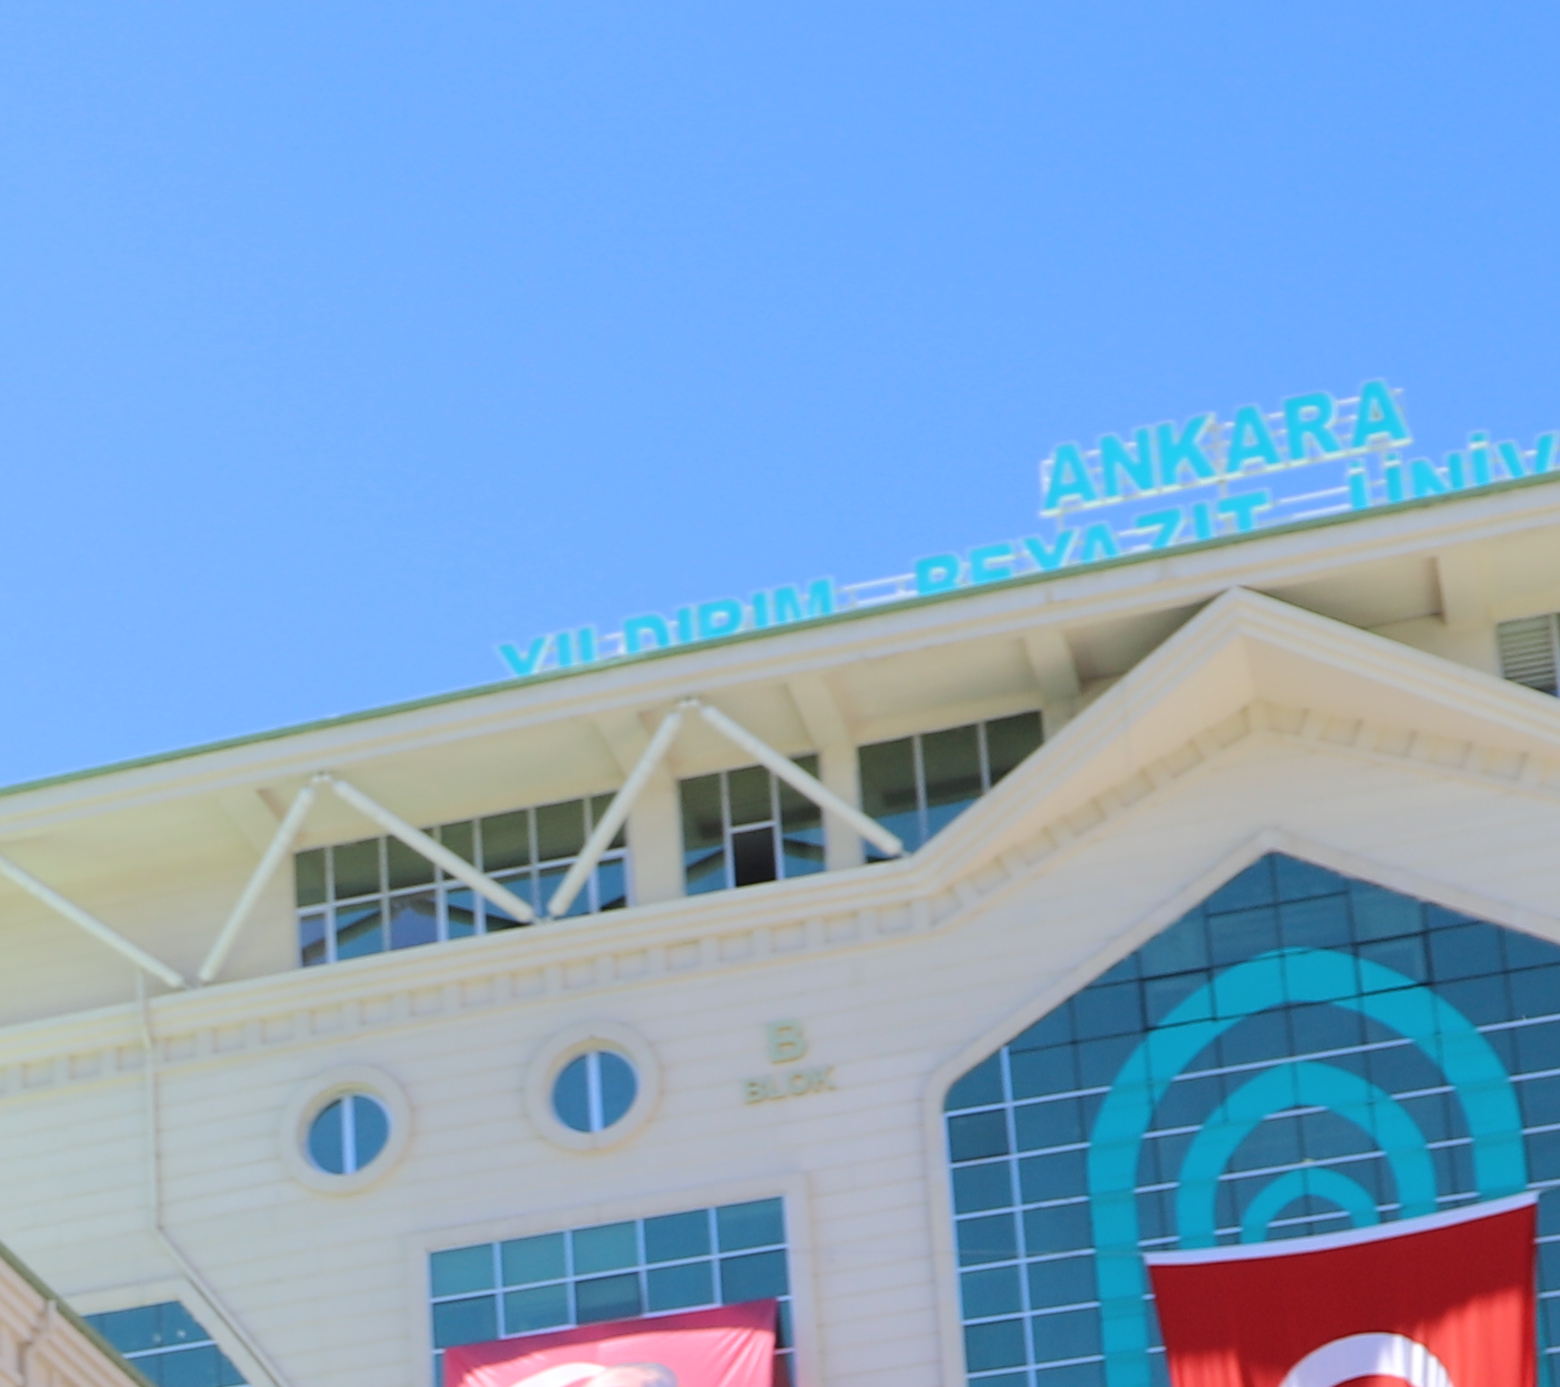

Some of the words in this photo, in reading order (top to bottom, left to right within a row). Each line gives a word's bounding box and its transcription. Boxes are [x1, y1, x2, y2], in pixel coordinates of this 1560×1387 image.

[1042, 379, 1411, 515] ANKARA
[766, 1020, 809, 1064] B
[742, 1066, 838, 1106] BLOK
